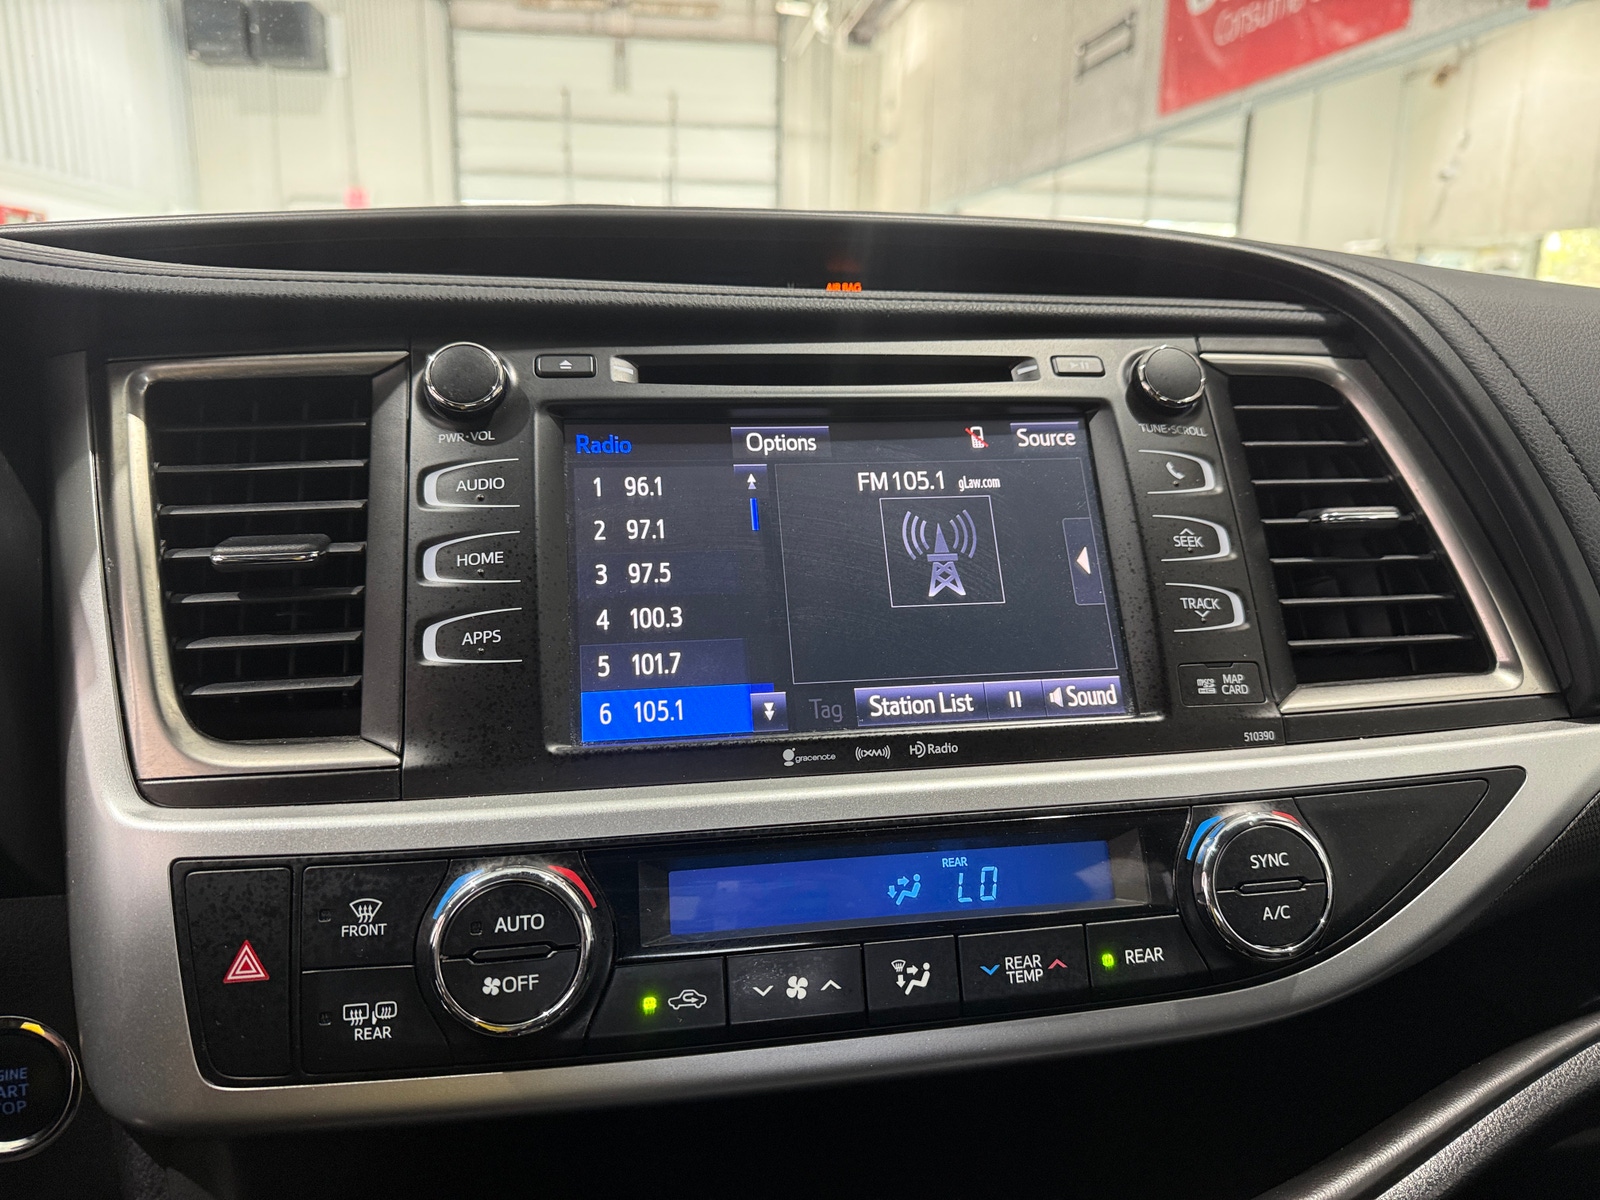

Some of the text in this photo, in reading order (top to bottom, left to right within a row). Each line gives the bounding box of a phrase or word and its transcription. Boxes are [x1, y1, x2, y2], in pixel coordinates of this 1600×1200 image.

[575, 434, 633, 454] Radio
[745, 432, 817, 455] Options
[1016, 428, 1076, 447] Source
[456, 477, 505, 492] AUDIO
[593, 476, 663, 497] 1 96.1
[857, 472, 889, 491] FM
[892, 470, 944, 491] 105.1
[594, 518, 665, 540] 2 97.1
[1173, 535, 1204, 548] SEEK
[456, 551, 504, 567] HOME
[595, 562, 672, 584] 3 97.5
[1180, 597, 1221, 610] TRACK
[596, 606, 683, 630] 4 100.3
[461, 630, 502, 645] APPS
[597, 652, 682, 677] 5 101.7
[1222, 673, 1245, 684] MAP
[1065, 685, 1118, 707] Sound
[1221, 684, 1249, 695] CARD
[599, 699, 684, 724] 6 105.1
[809, 698, 843, 722] Tag
[869, 692, 974, 717] Station List
[1243, 731, 1275, 742] 510390
[927, 743, 959, 754] Radio
[795, 753, 836, 764] gracenote
[941, 856, 968, 868] REAR
[1249, 852, 1290, 870] SYNC
[957, 865, 998, 903] LO
[1262, 904, 1291, 922] A/C
[341, 923, 387, 937] FRONT
[494, 913, 545, 934] AUTO
[1005, 954, 1042, 971] REAR
[1124, 947, 1164, 965] REAR
[502, 974, 540, 993] OFF
[1006, 968, 1043, 985] TEMP
[354, 1026, 392, 1040] REAR
[0, 1067, 28, 1082] GINE
[0, 1083, 29, 1099] ART
[0, 1100, 27, 1115] OP
